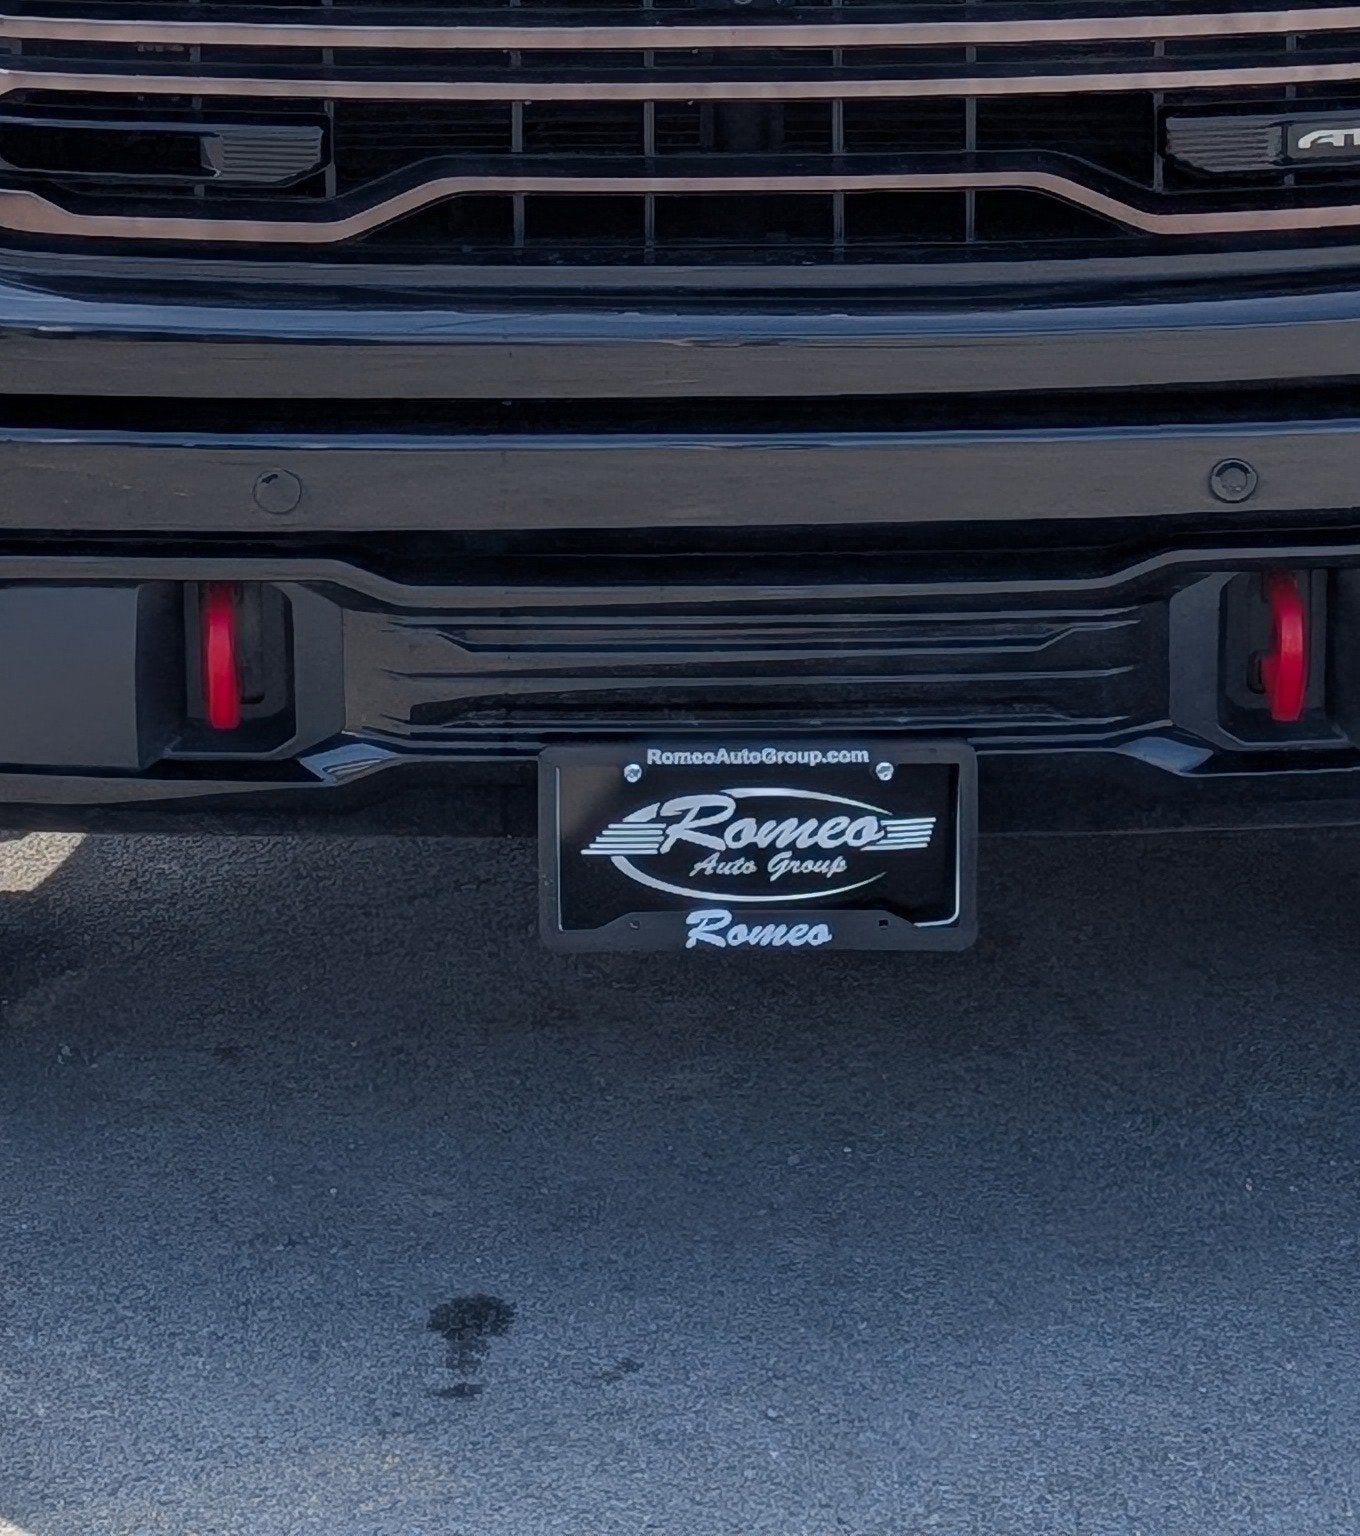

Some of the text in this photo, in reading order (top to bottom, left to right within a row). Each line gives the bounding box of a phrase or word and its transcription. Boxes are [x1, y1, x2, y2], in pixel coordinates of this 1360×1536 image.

[646, 748, 870, 766] RomeoAutoGroup.com
[659, 794, 885, 854] Romeo
[689, 850, 848, 882] Auto Group
[685, 909, 833, 949] Romeo
